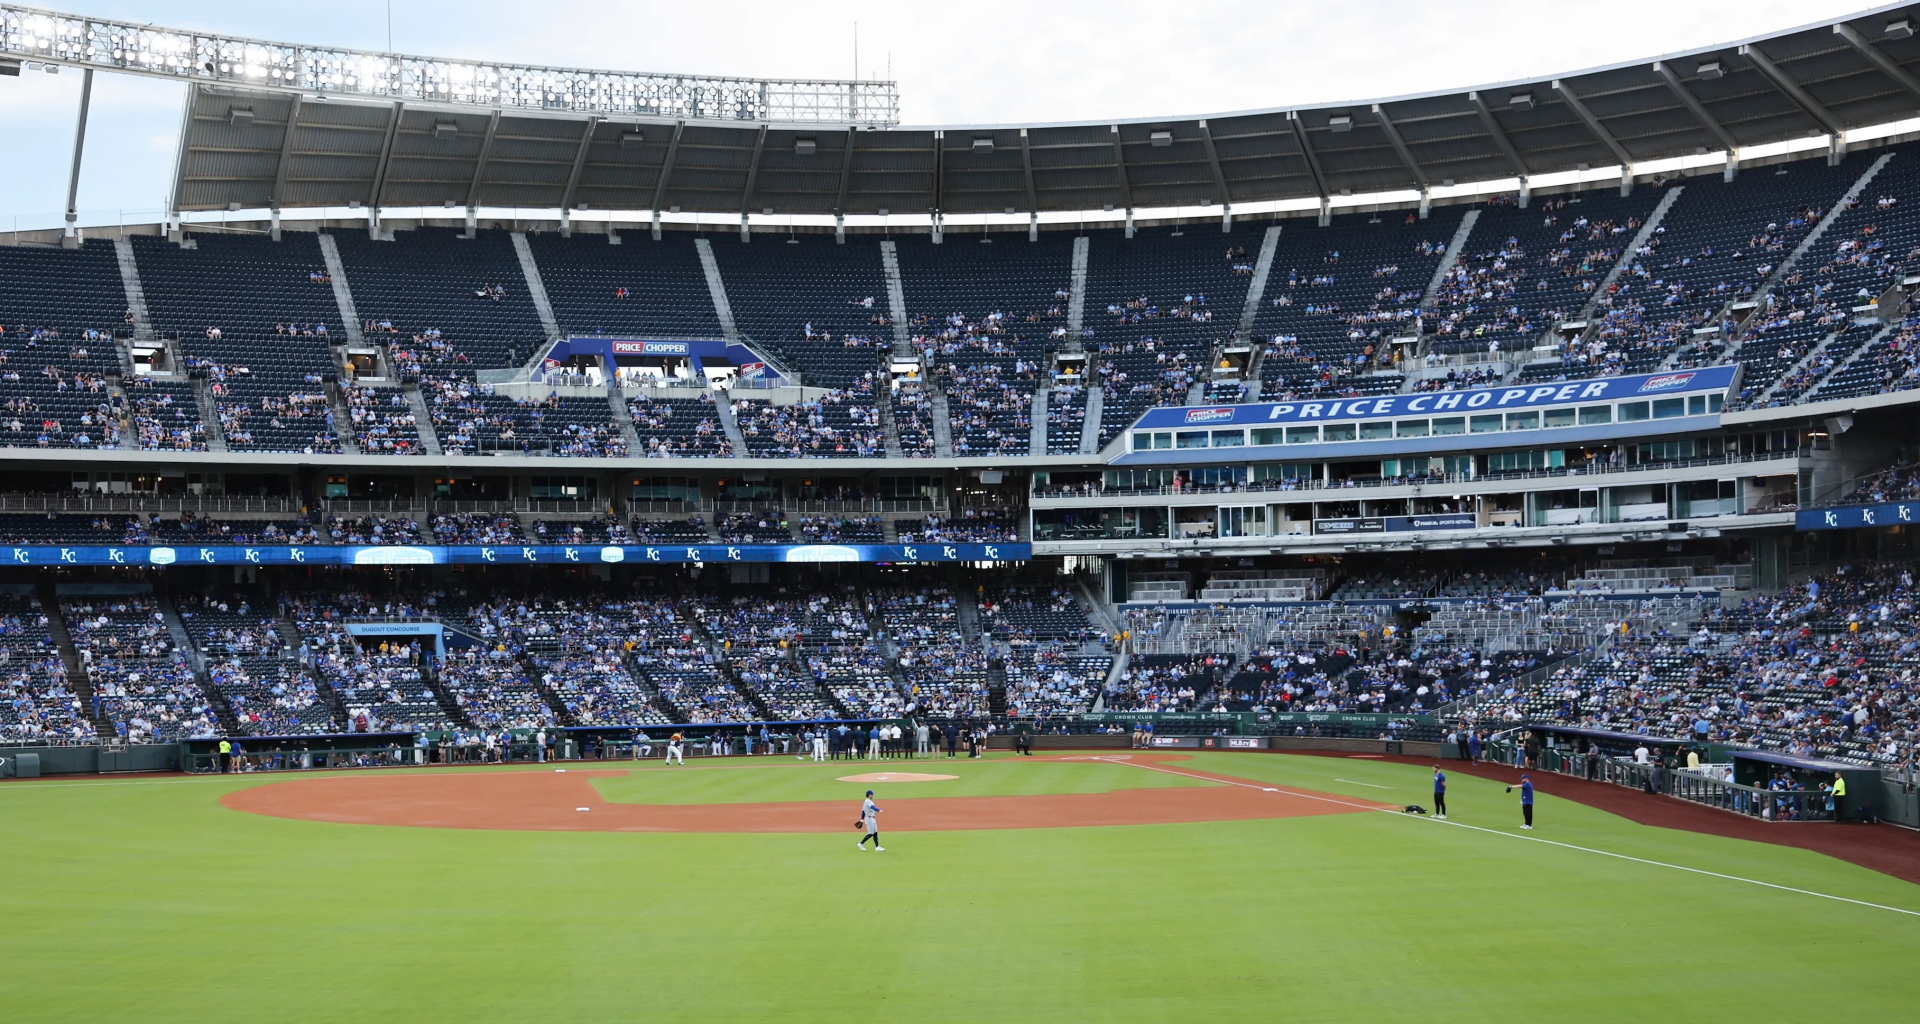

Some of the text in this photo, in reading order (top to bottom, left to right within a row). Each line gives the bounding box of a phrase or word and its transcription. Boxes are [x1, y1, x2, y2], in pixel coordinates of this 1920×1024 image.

[616, 343, 686, 353] PRICE CHOPPER
[1641, 378, 1688, 391] CHOPPER
[1649, 374, 1677, 385] PRICE
[1268, 381, 1610, 420] PRICE CHOPPER
[1187, 412, 1232, 422] CHOPPER
[1190, 409, 1218, 417] PRICE
